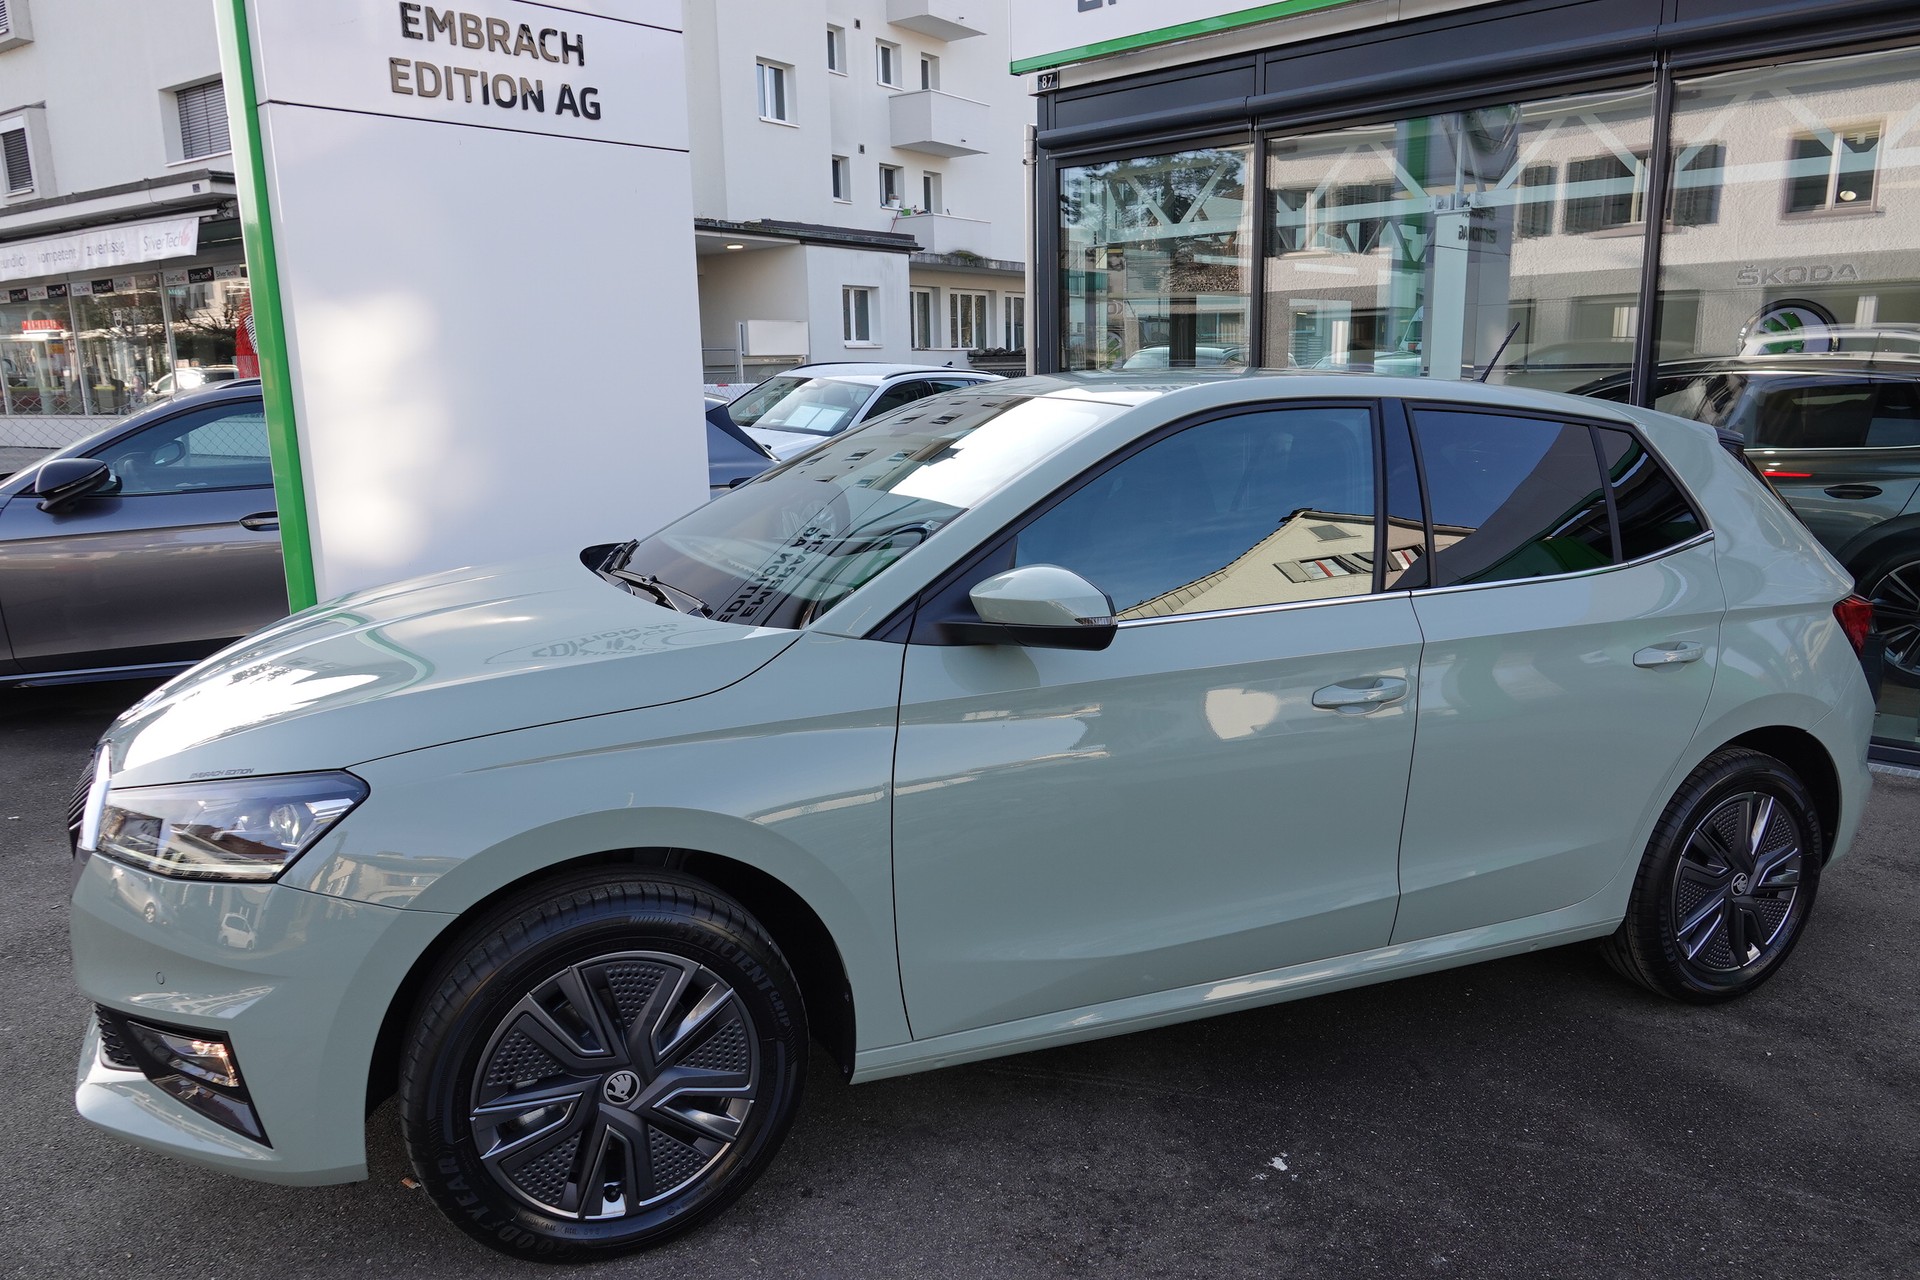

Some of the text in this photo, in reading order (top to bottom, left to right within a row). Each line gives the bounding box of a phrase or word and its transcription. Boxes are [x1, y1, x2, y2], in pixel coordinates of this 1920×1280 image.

[399, 1, 586, 67] EMBRACH
[388, 57, 602, 121] EDITION AG
[1042, 75, 1053, 88] 87
[1736, 263, 1860, 286] ŠKODA
